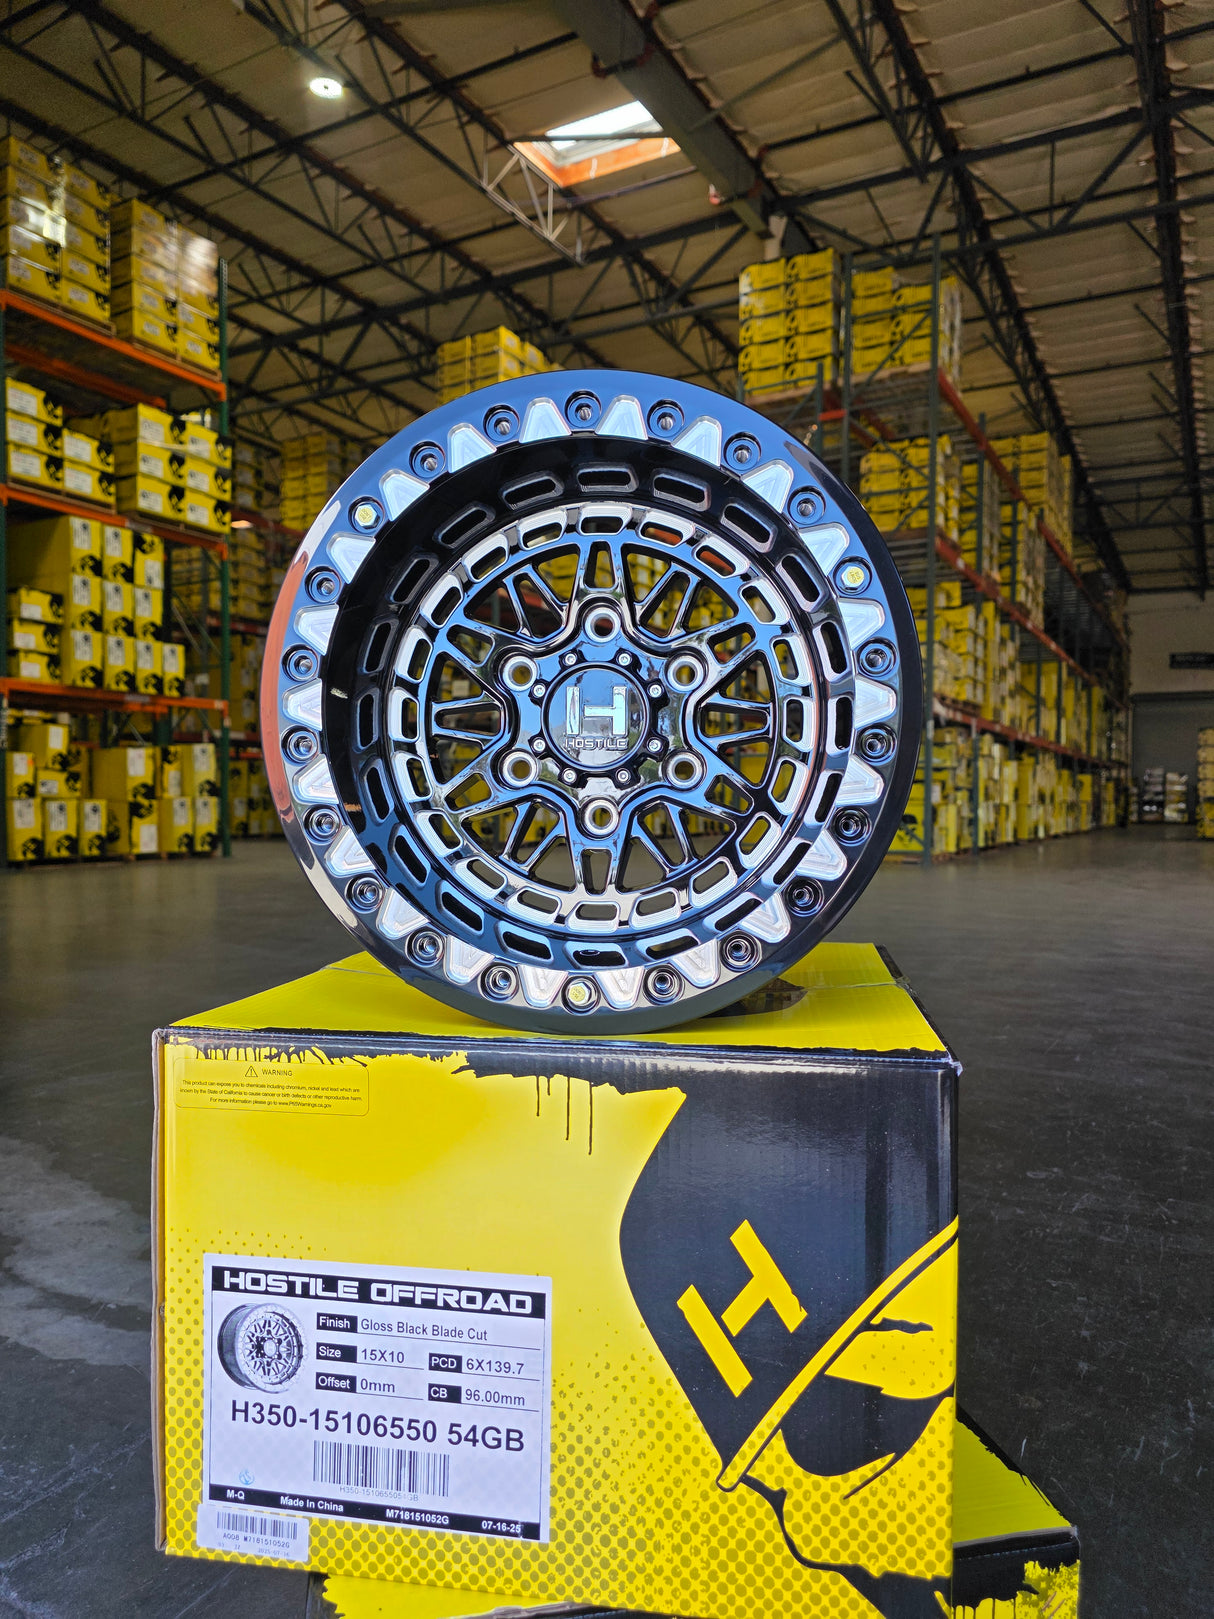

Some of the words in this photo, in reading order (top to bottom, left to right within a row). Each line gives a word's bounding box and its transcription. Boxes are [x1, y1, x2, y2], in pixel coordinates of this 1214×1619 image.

[565, 738, 628, 750] HOSTILE
[262, 1068, 293, 1077] WARNING
[223, 1270, 359, 1300] HOSTILE
[370, 1282, 533, 1315] OFFROAD
[319, 1315, 350, 1329] Finish
[360, 1318, 393, 1332] Gloss
[396, 1321, 428, 1336] Black
[432, 1324, 464, 1339] Blade
[467, 1327, 488, 1341] Cut
[318, 1345, 342, 1358] Size
[361, 1348, 405, 1364] 15X10
[431, 1356, 457, 1369] PCD
[466, 1358, 525, 1375] 6X139.7
[318, 1375, 351, 1389] Offset
[360, 1378, 395, 1393] 0mm
[430, 1386, 448, 1398] CB
[465, 1388, 525, 1407] 96.00mm
[231, 1400, 437, 1443] H350-15106550
[447, 1422, 525, 1452] 54GB
[226, 1489, 246, 1500] M-Q
[280, 1495, 304, 1507] Made
[306, 1499, 316, 1509] In
[317, 1500, 344, 1512] China
[385, 1508, 449, 1525] M718151052G
[481, 1519, 522, 1534] 07-16-25
